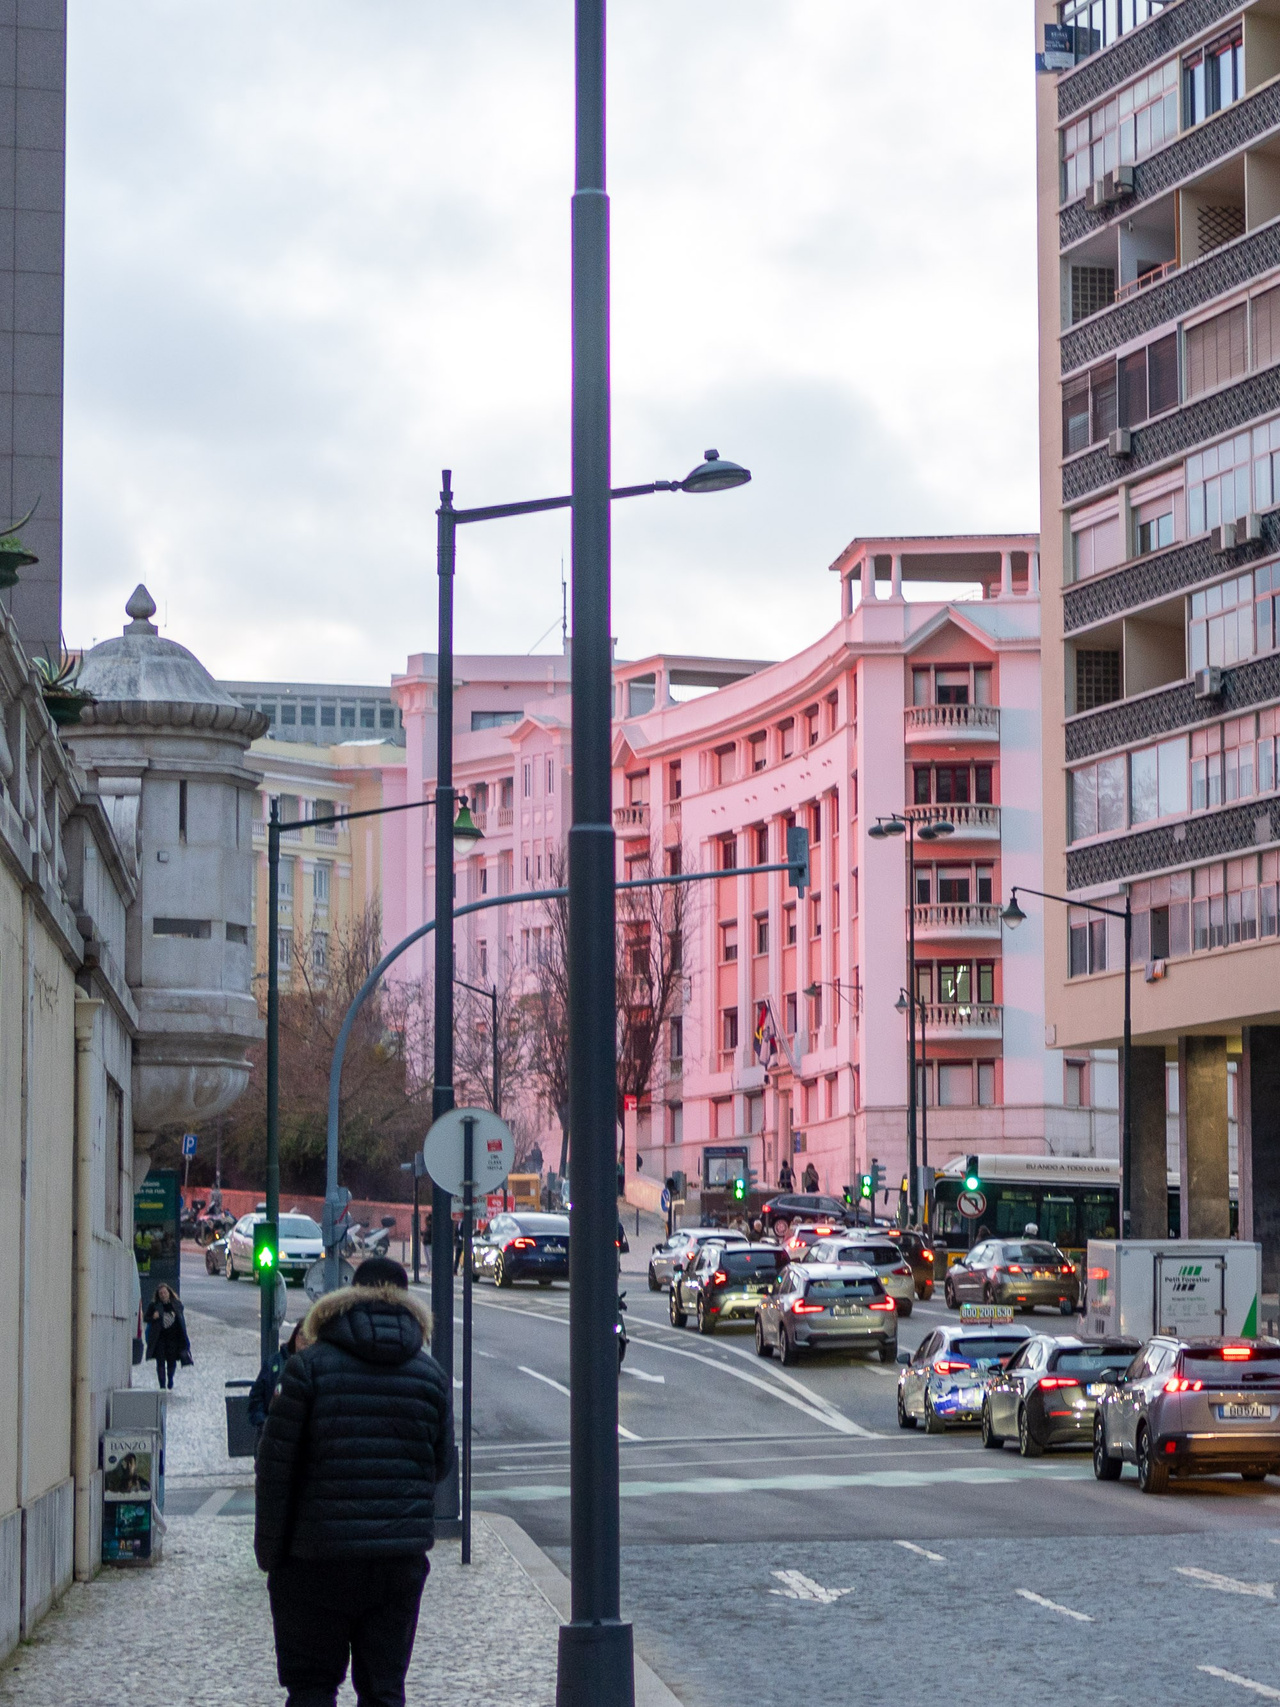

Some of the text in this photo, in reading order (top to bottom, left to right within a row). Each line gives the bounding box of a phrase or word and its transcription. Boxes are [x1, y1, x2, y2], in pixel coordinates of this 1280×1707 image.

[186, 1136, 195, 1152] P
[1165, 1275, 1210, 1284] Petit Forestier
[962, 1306, 1013, 1318] 800 200 530
[110, 1442, 147, 1451] BANZO
